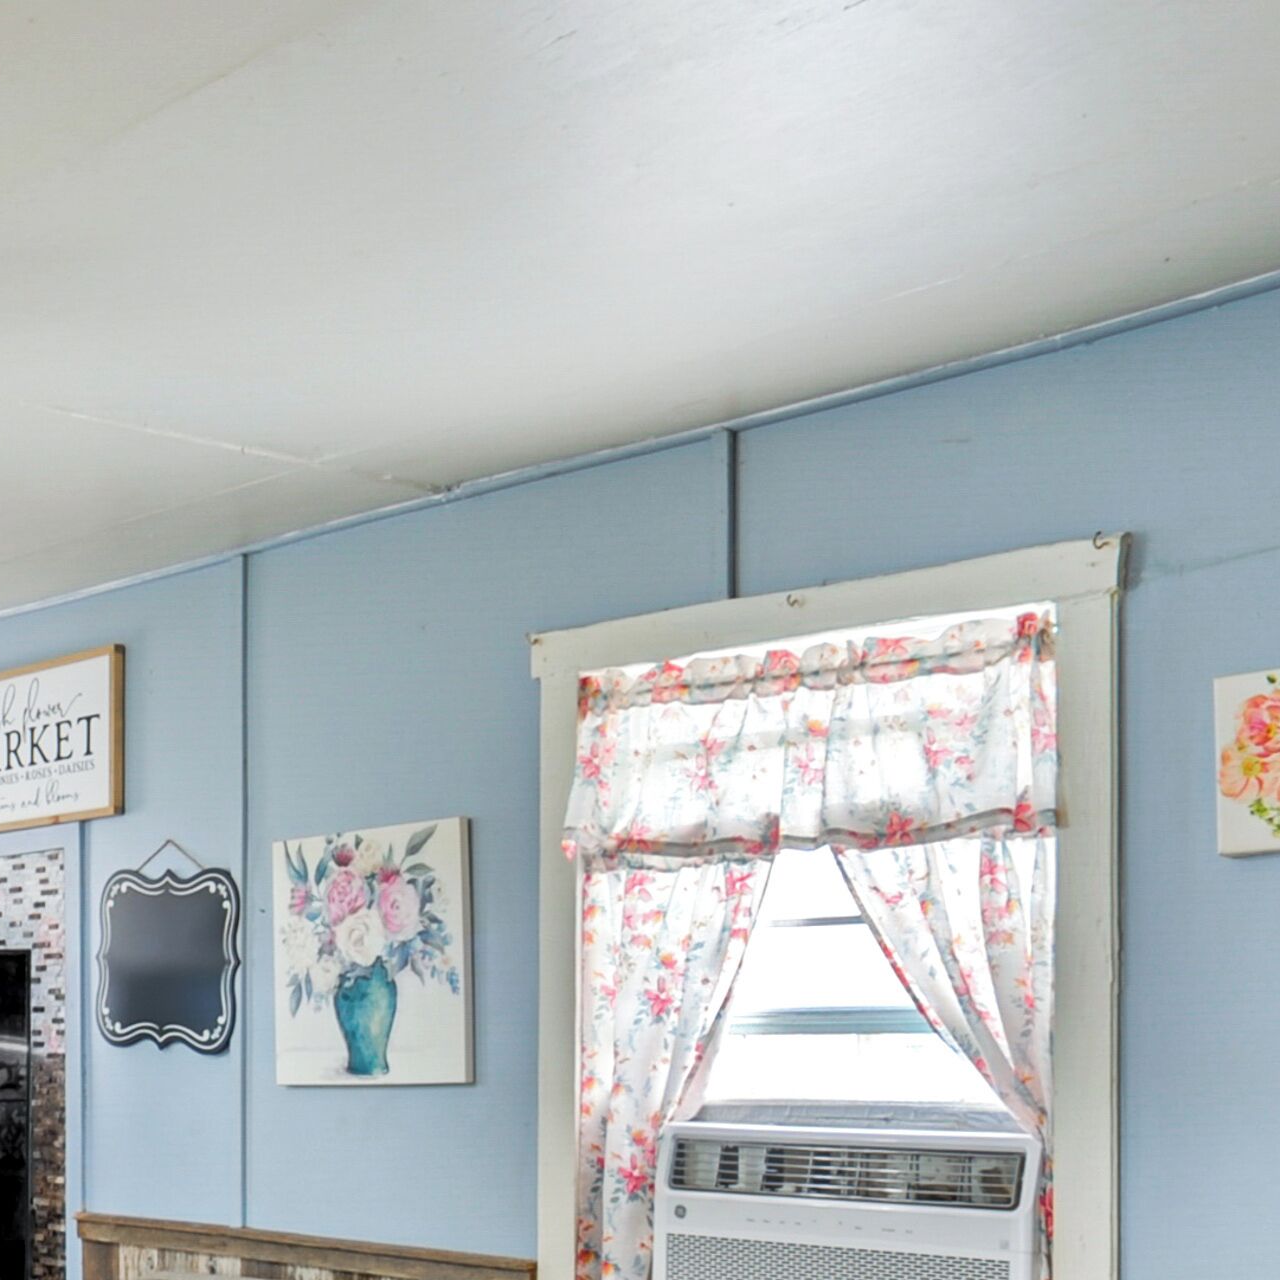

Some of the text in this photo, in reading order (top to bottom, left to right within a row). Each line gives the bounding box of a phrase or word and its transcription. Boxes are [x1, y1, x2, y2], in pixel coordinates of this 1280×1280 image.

[22, 677, 83, 743] flower
[25, 767, 52, 781] ROSES
[58, 759, 96, 776] DAISIES
